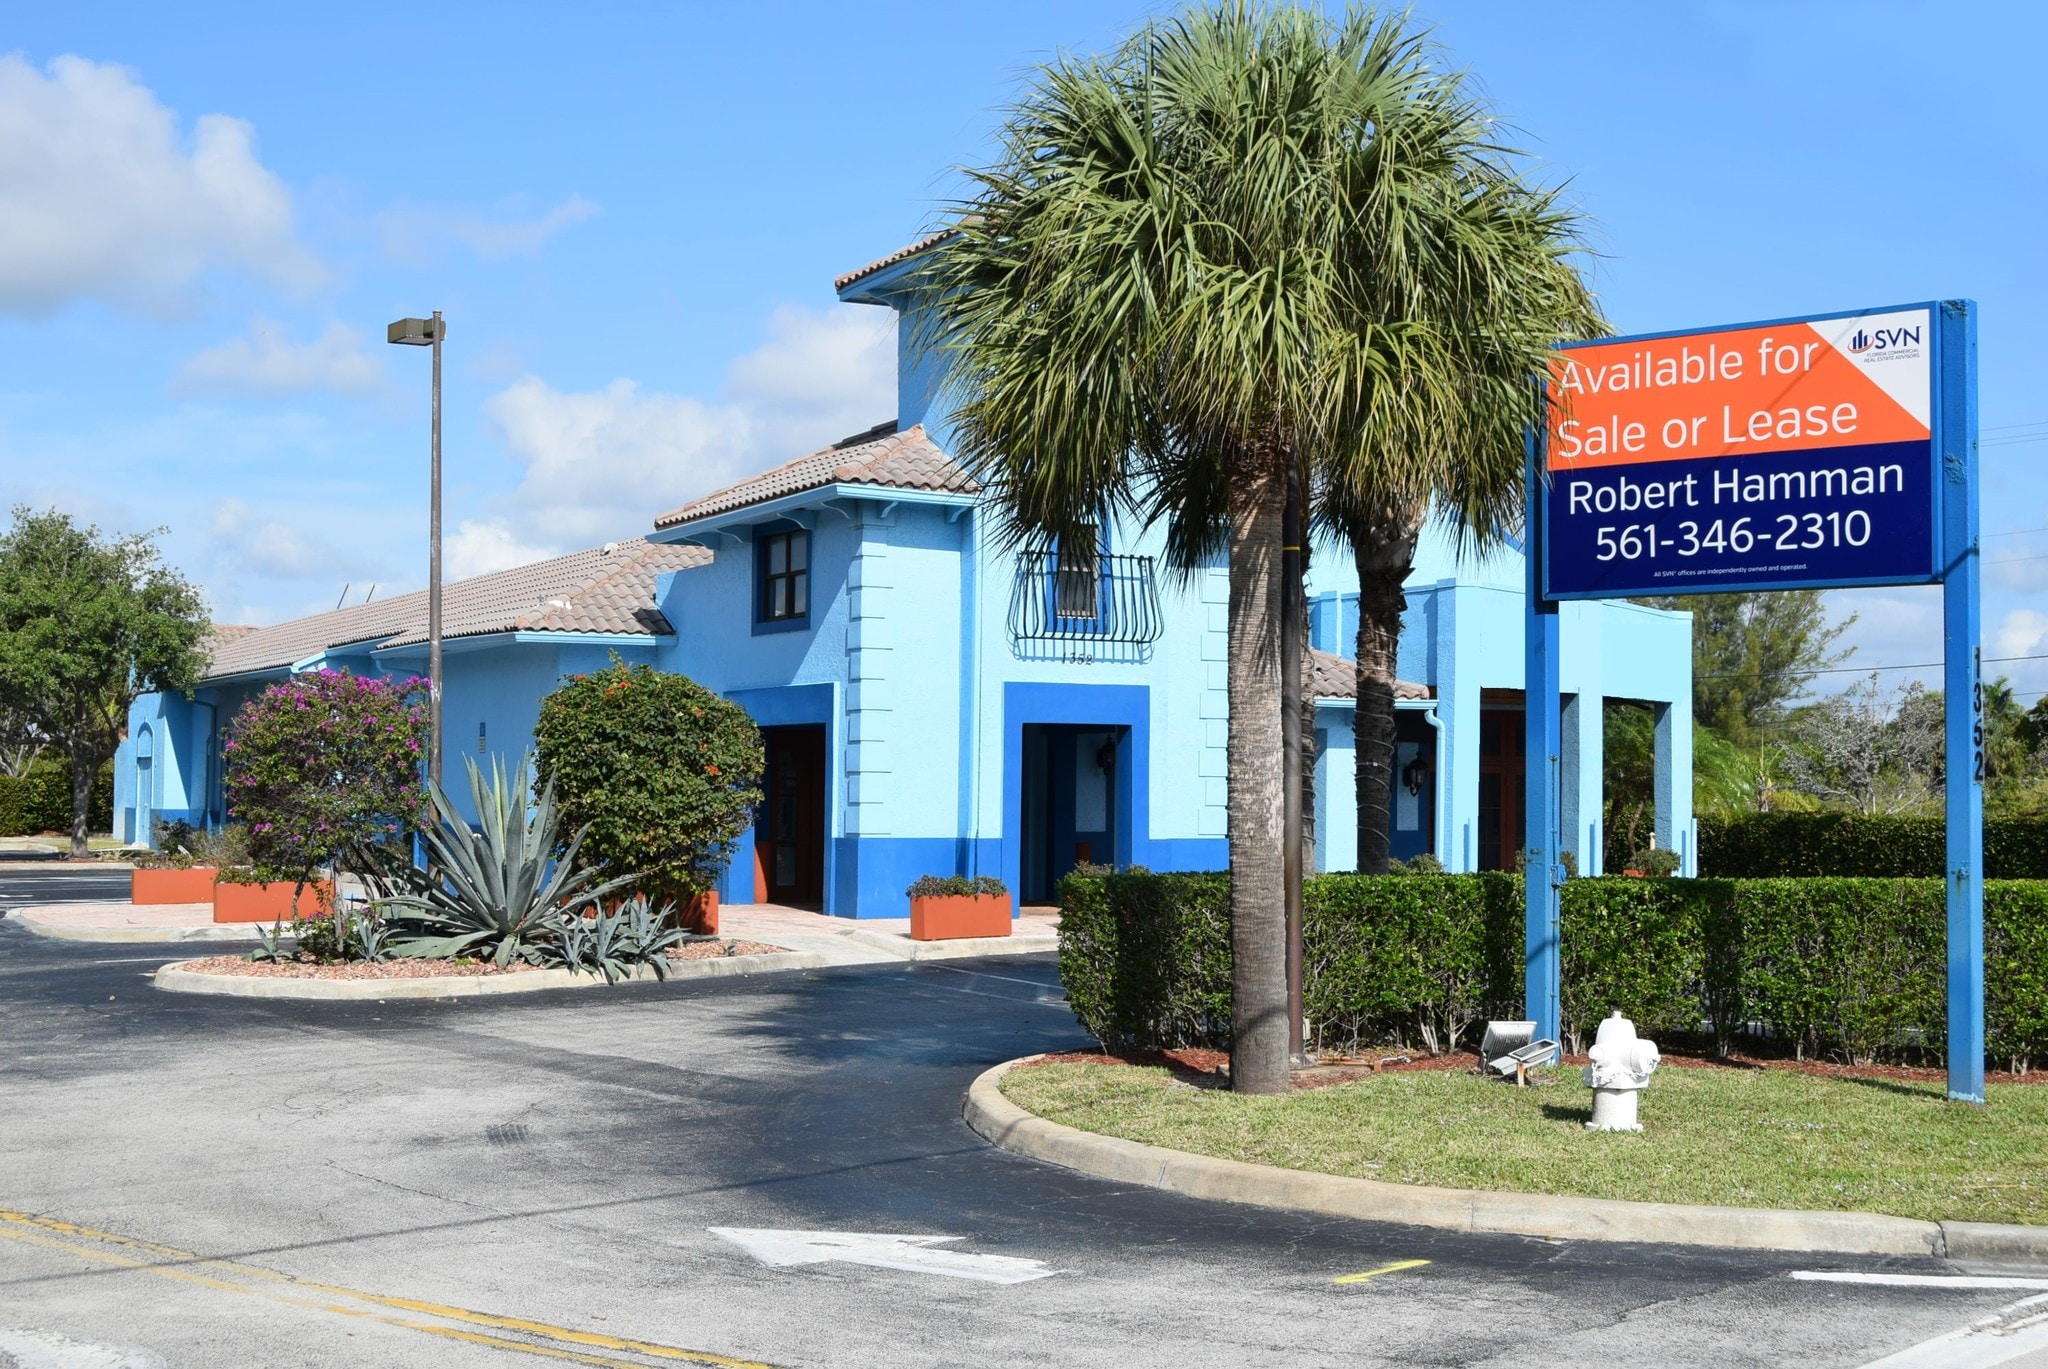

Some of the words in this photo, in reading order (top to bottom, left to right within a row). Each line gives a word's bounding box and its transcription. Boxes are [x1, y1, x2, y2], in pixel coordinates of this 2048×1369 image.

[1875, 326, 1920, 349] SVN
[1557, 344, 1743, 397] Available
[1758, 337, 1819, 376] for
[1558, 415, 1646, 458] Sale
[1662, 415, 1707, 449] or
[1723, 402, 1858, 444] Lease
[1569, 473, 1699, 515] Robert
[1713, 463, 1903, 504] Hamman
[1596, 510, 1872, 562] 561-346-2310
[1707, 567, 1746, 575] independently
[1780, 564, 1808, 572] operated.
[1062, 652, 1092, 665] 1352
[1973, 646, 1984, 781] 1352
